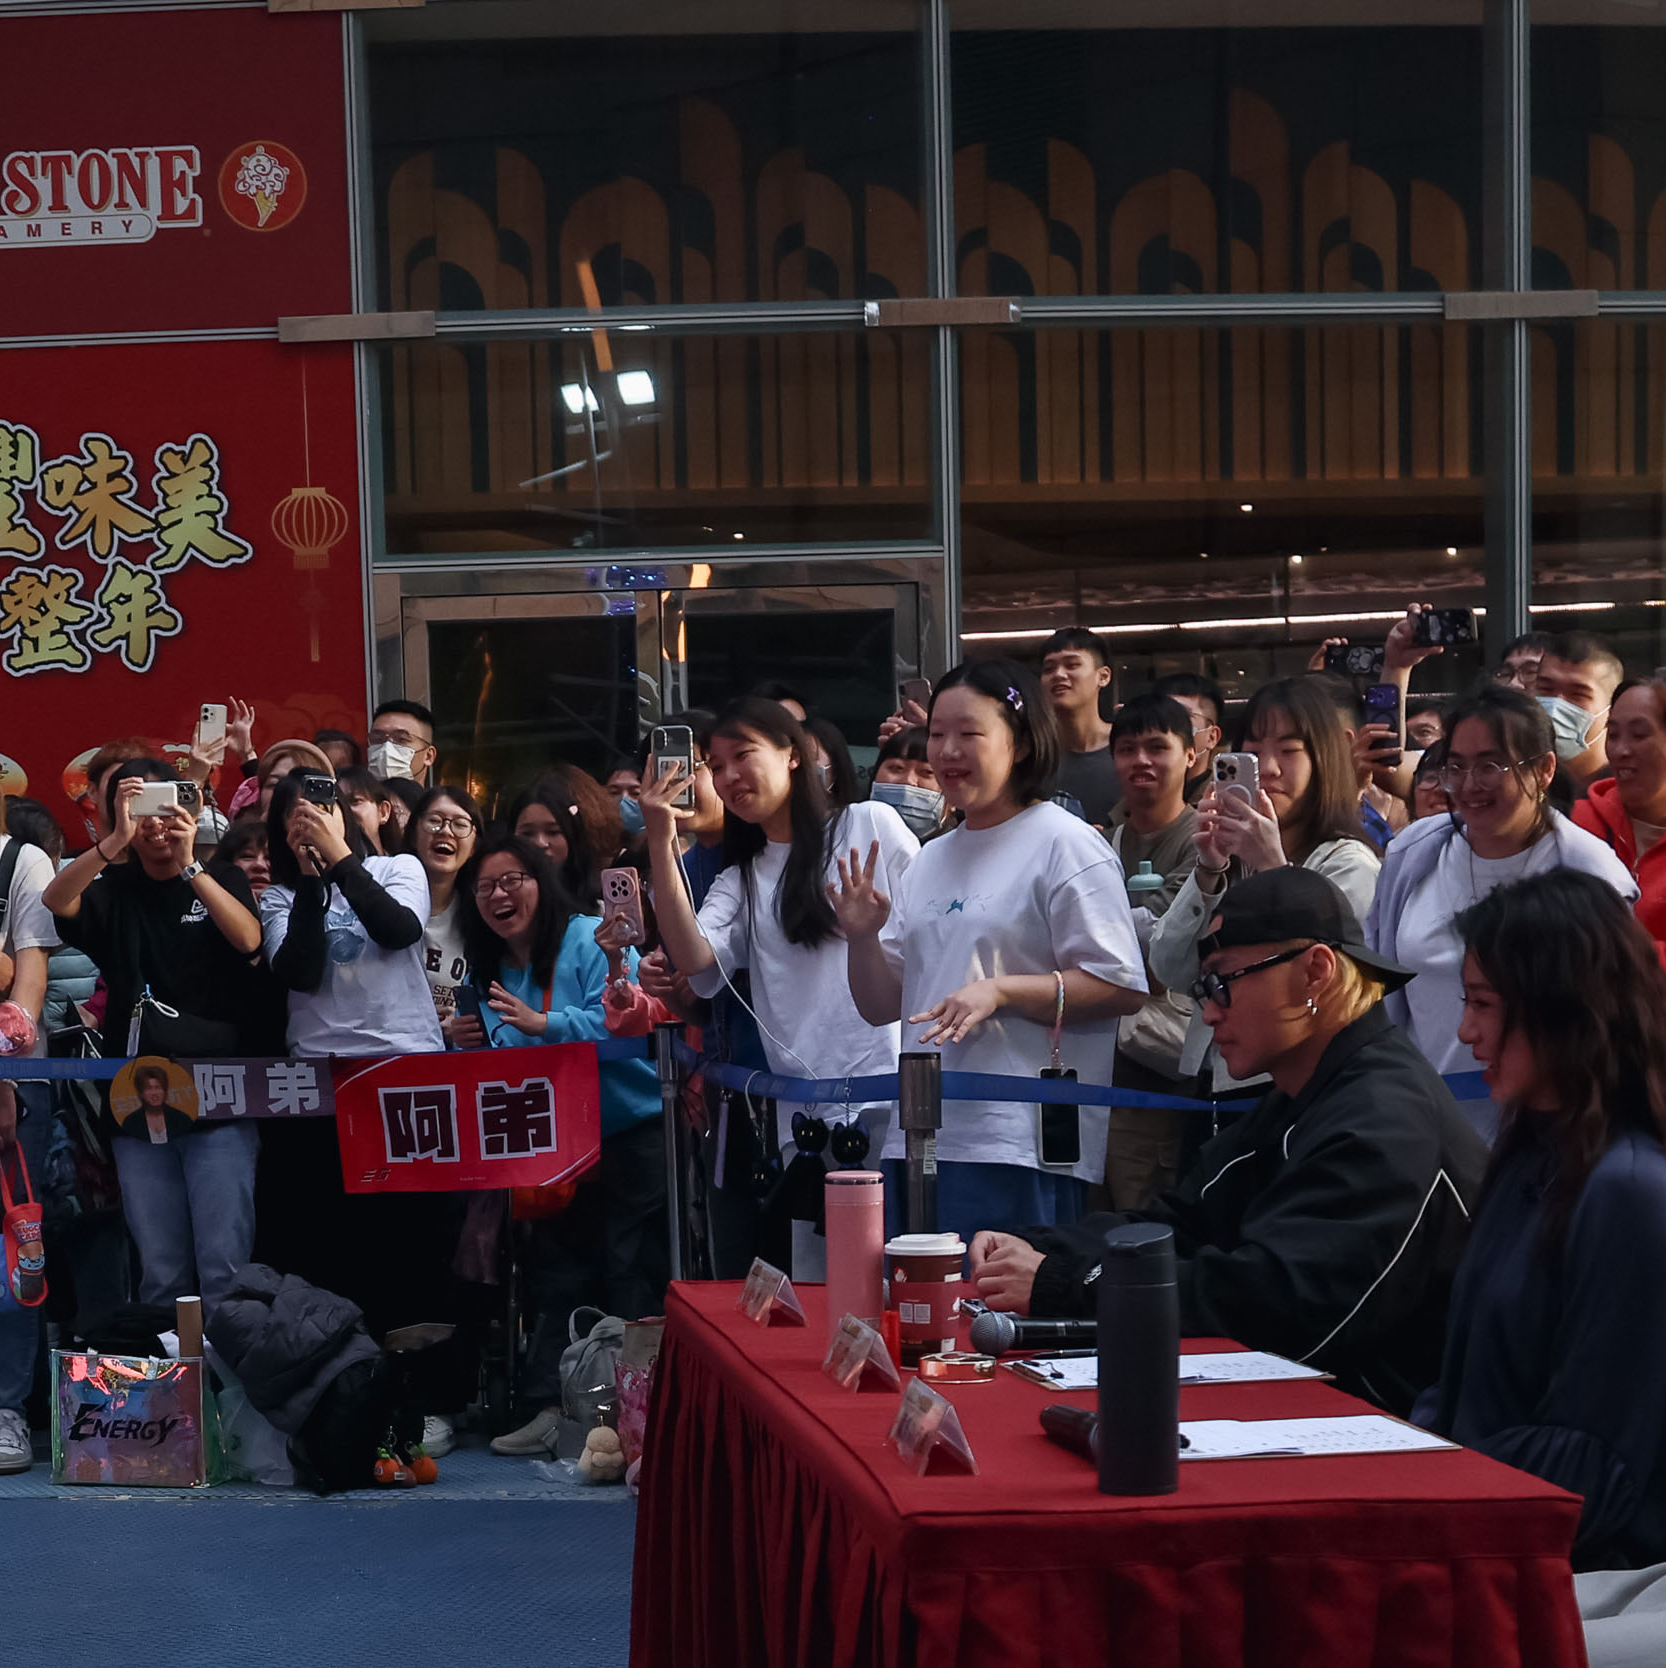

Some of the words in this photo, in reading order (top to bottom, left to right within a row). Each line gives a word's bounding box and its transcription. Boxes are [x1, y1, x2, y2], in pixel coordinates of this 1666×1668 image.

[3, 146, 203, 230] STONE
[192, 1062, 320, 1116] 阿弟
[378, 1077, 557, 1163] 阿弟
